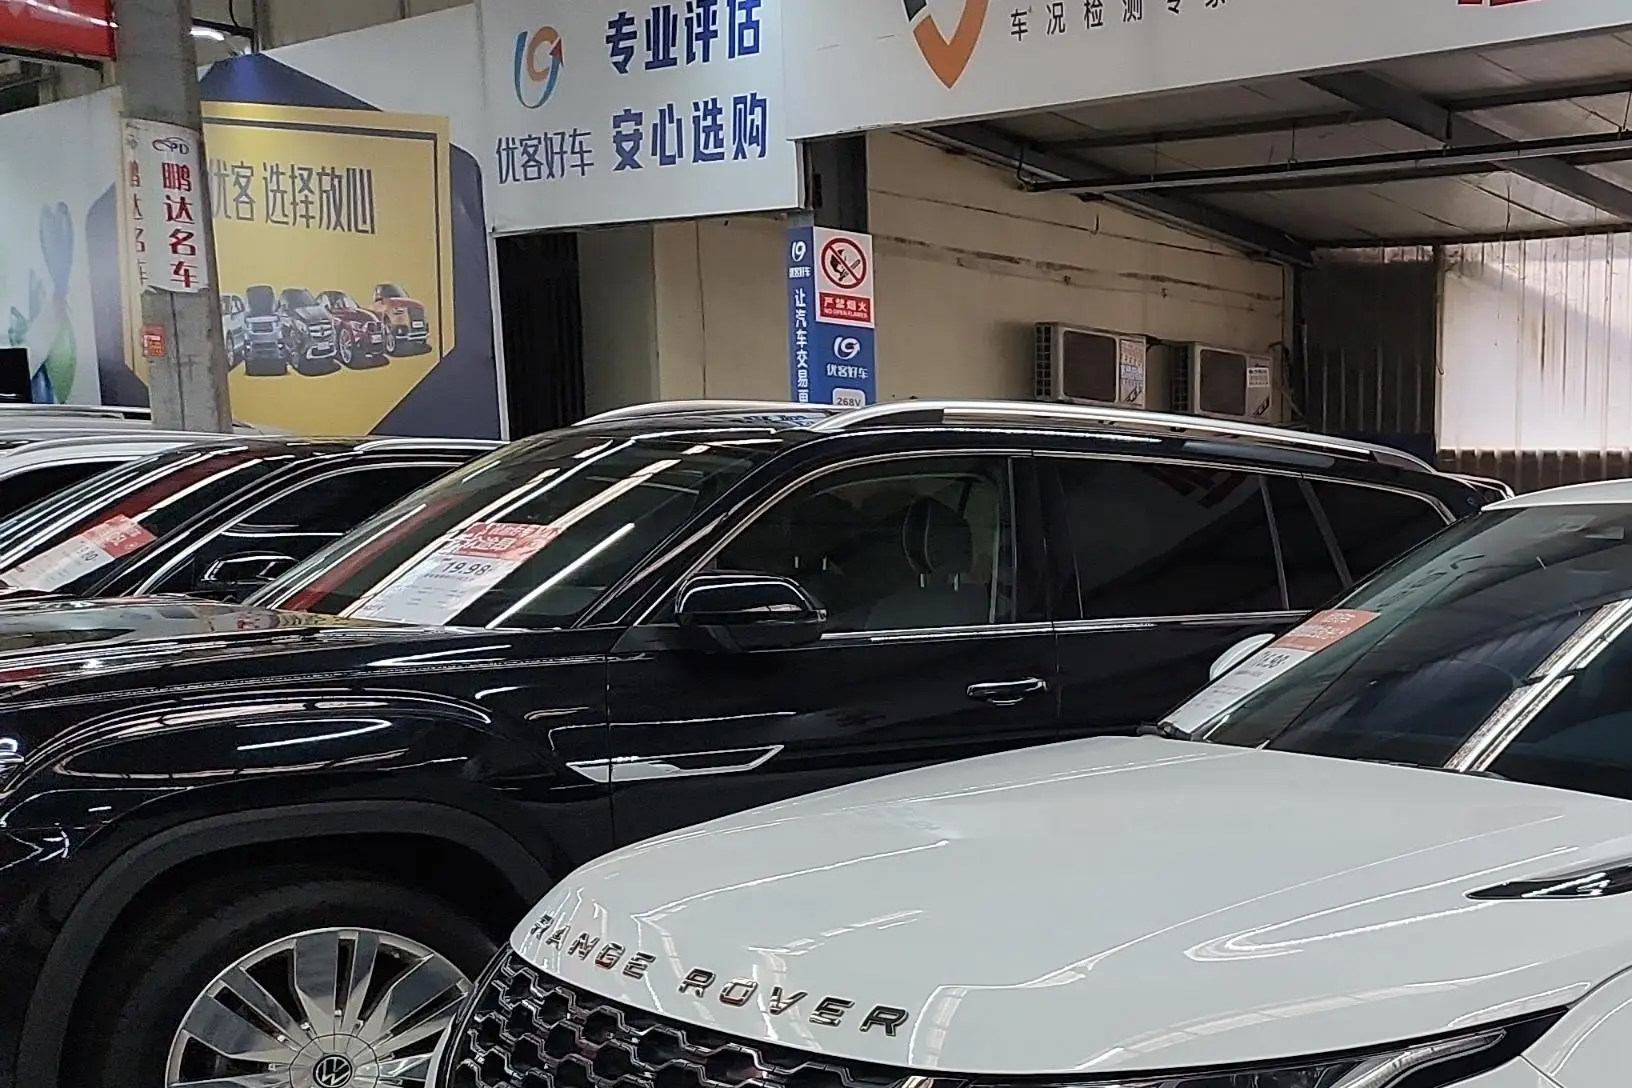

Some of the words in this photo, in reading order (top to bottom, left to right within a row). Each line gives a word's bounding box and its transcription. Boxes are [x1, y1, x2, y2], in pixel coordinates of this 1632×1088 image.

[605, 0, 761, 74] 专业评估
[1010, 0, 1226, 41] 车况检测
[496, 127, 594, 184] 优客好车
[612, 92, 767, 171] 安心选购
[161, 161, 200, 288] 鹏达名车
[262, 161, 375, 235] 选择放心
[826, 363, 869, 379] 优客好车
[442, 561, 491, 576] 19.98
[530, 913, 656, 980] RANGE
[679, 967, 909, 1037] ROVER
